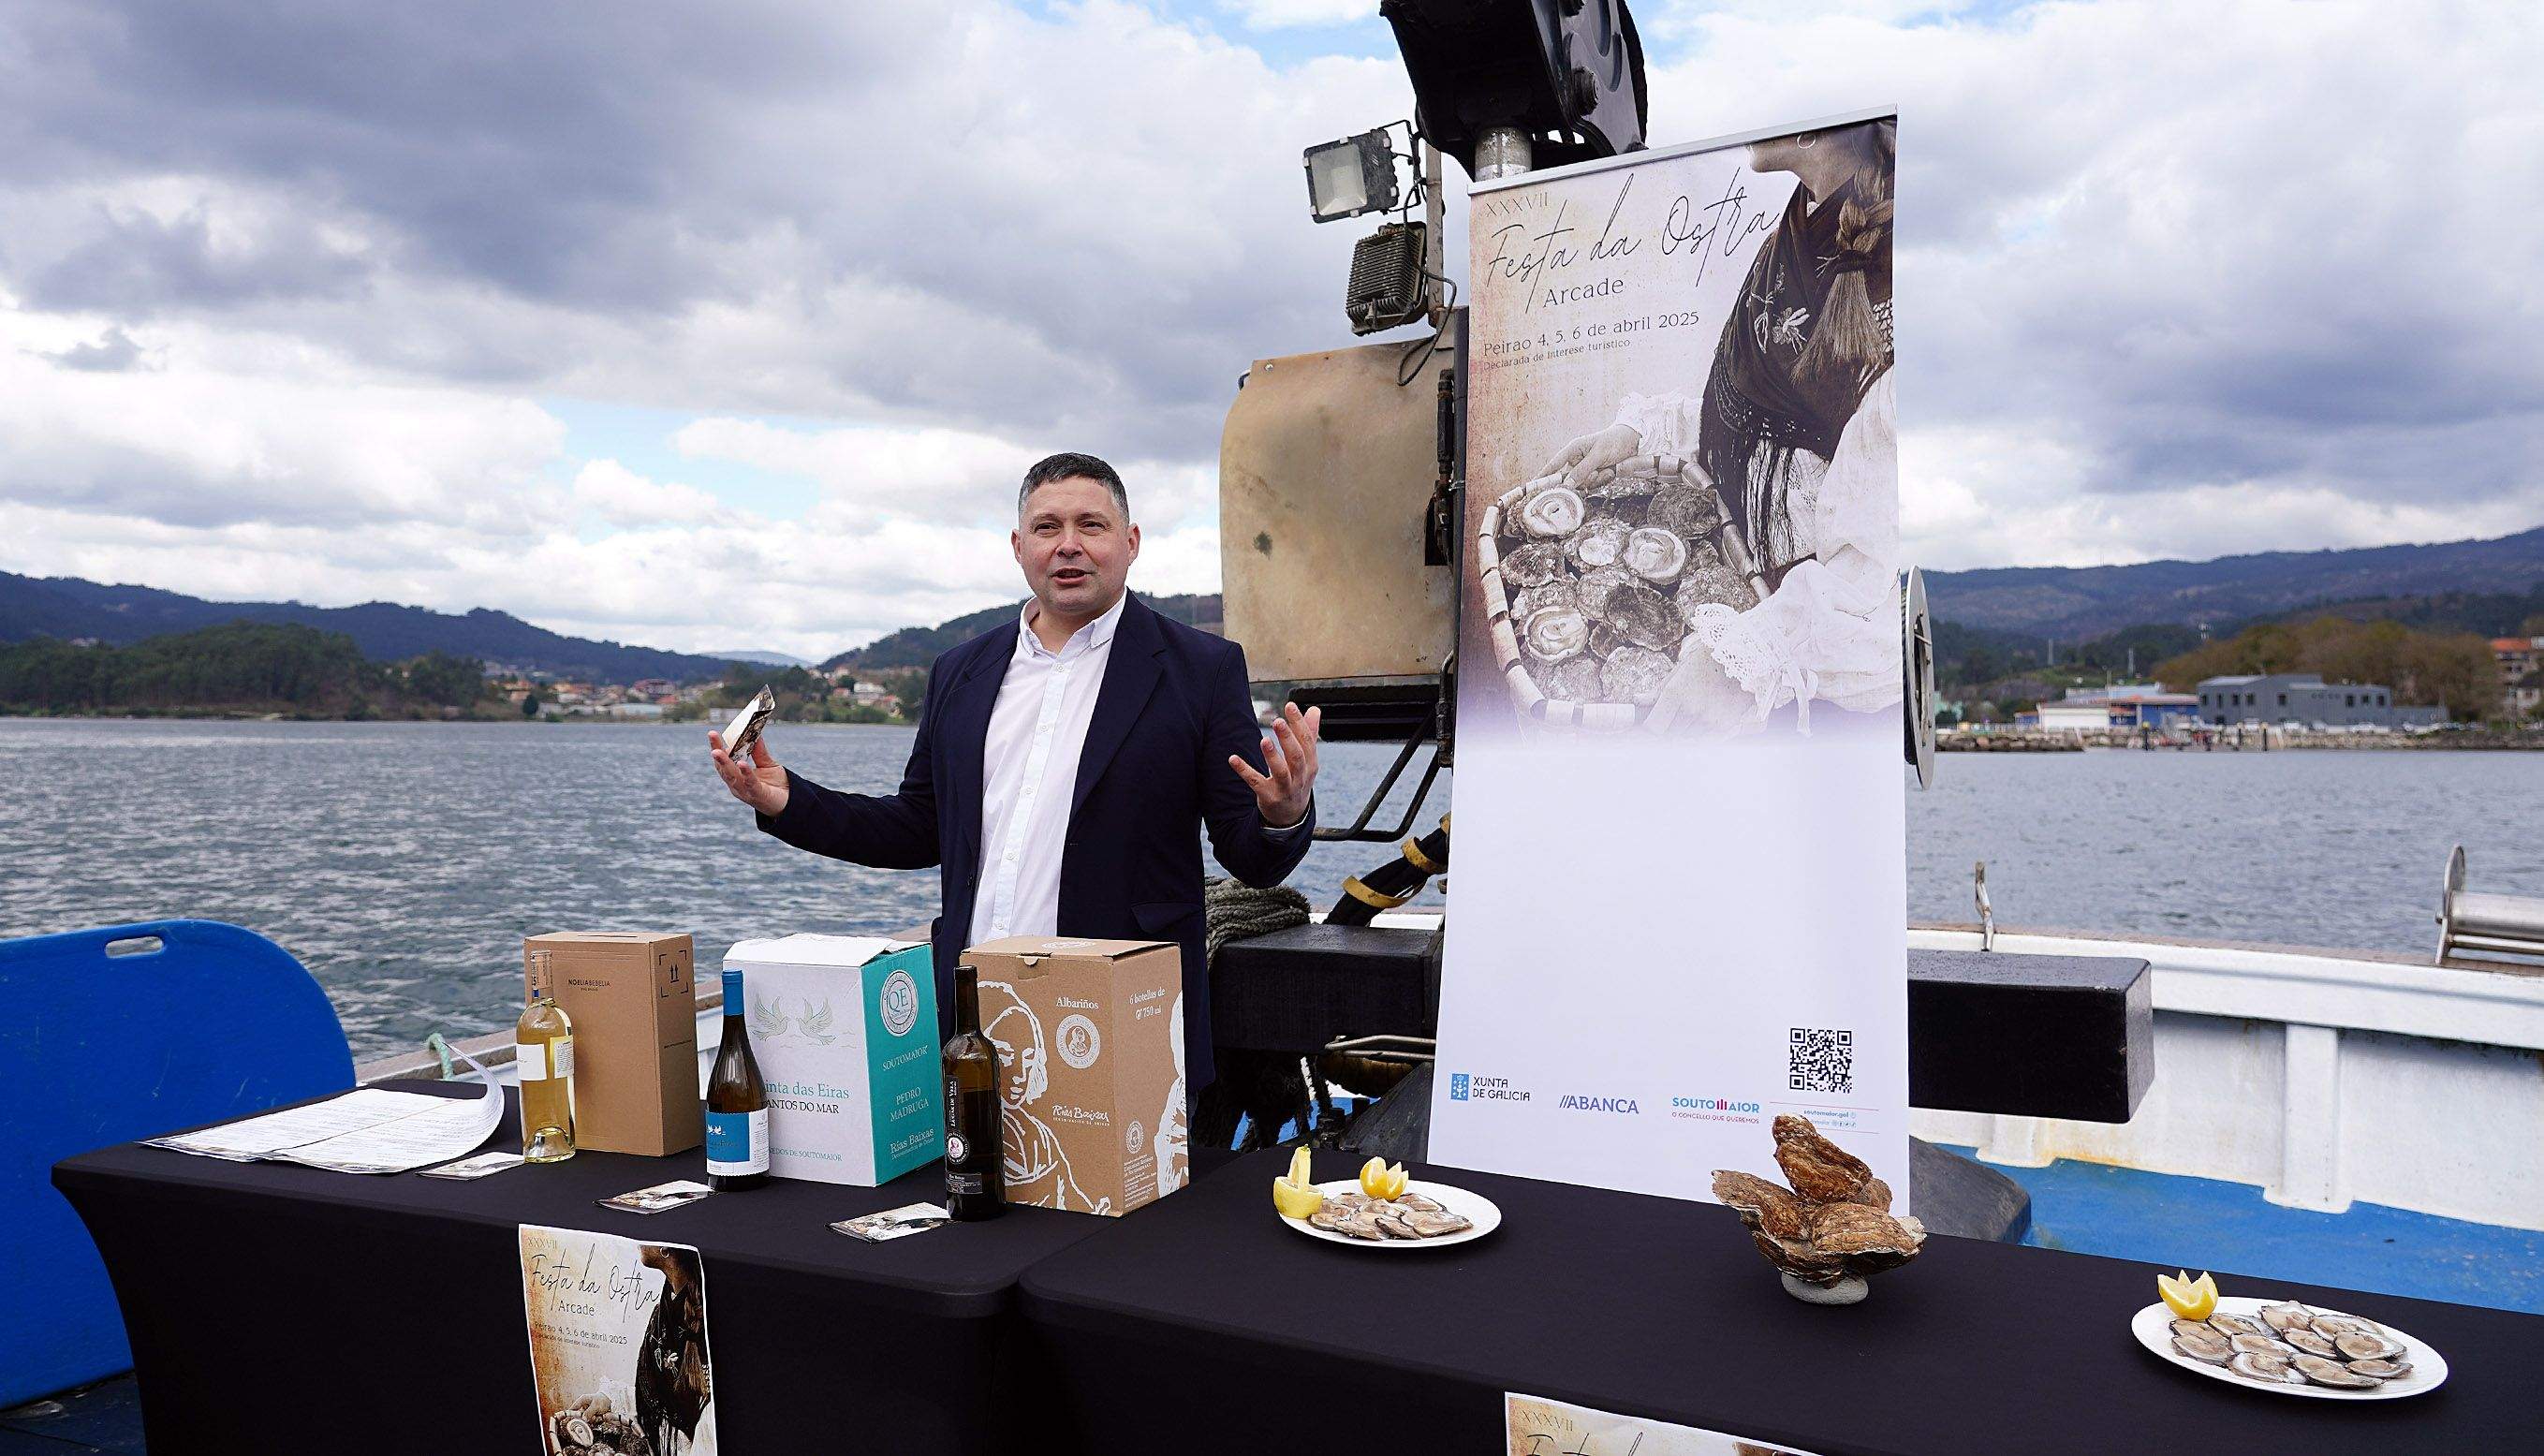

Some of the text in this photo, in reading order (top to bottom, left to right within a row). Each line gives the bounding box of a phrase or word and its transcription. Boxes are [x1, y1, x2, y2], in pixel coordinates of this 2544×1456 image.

[1486, 191, 1548, 217] XXXVII
[1487, 167, 1780, 314] Festa da Ostra
[1543, 278, 1624, 308] Arcade
[1483, 338, 1532, 358] Peirao
[1572, 326, 1581, 340] 6
[1587, 323, 1607, 338] de
[1612, 316, 1652, 334] abril
[1657, 311, 1699, 329] 2025
[1533, 352, 1544, 362] de
[888, 987, 909, 1013] QE
[1055, 996, 1099, 1009] Albariños
[766, 1079, 849, 1099] inta das Eiras
[1473, 1076, 1509, 1089] XUNTA
[895, 1086, 921, 1105] PEDRO
[1472, 1088, 1531, 1102] DE GALICIA
[766, 1098, 840, 1114] ANTOS DO MAR
[890, 1097, 930, 1123] MADRUGA
[799, 1151, 843, 1161] SOUTOMAIOR
[531, 1243, 659, 1323] Festa da Ostra
[558, 1300, 596, 1316] Arcade
[573, 1329, 579, 1337] 6
[581, 1330, 590, 1339] de
[591, 1331, 608, 1343] abril
[610, 1334, 628, 1345] 2025
